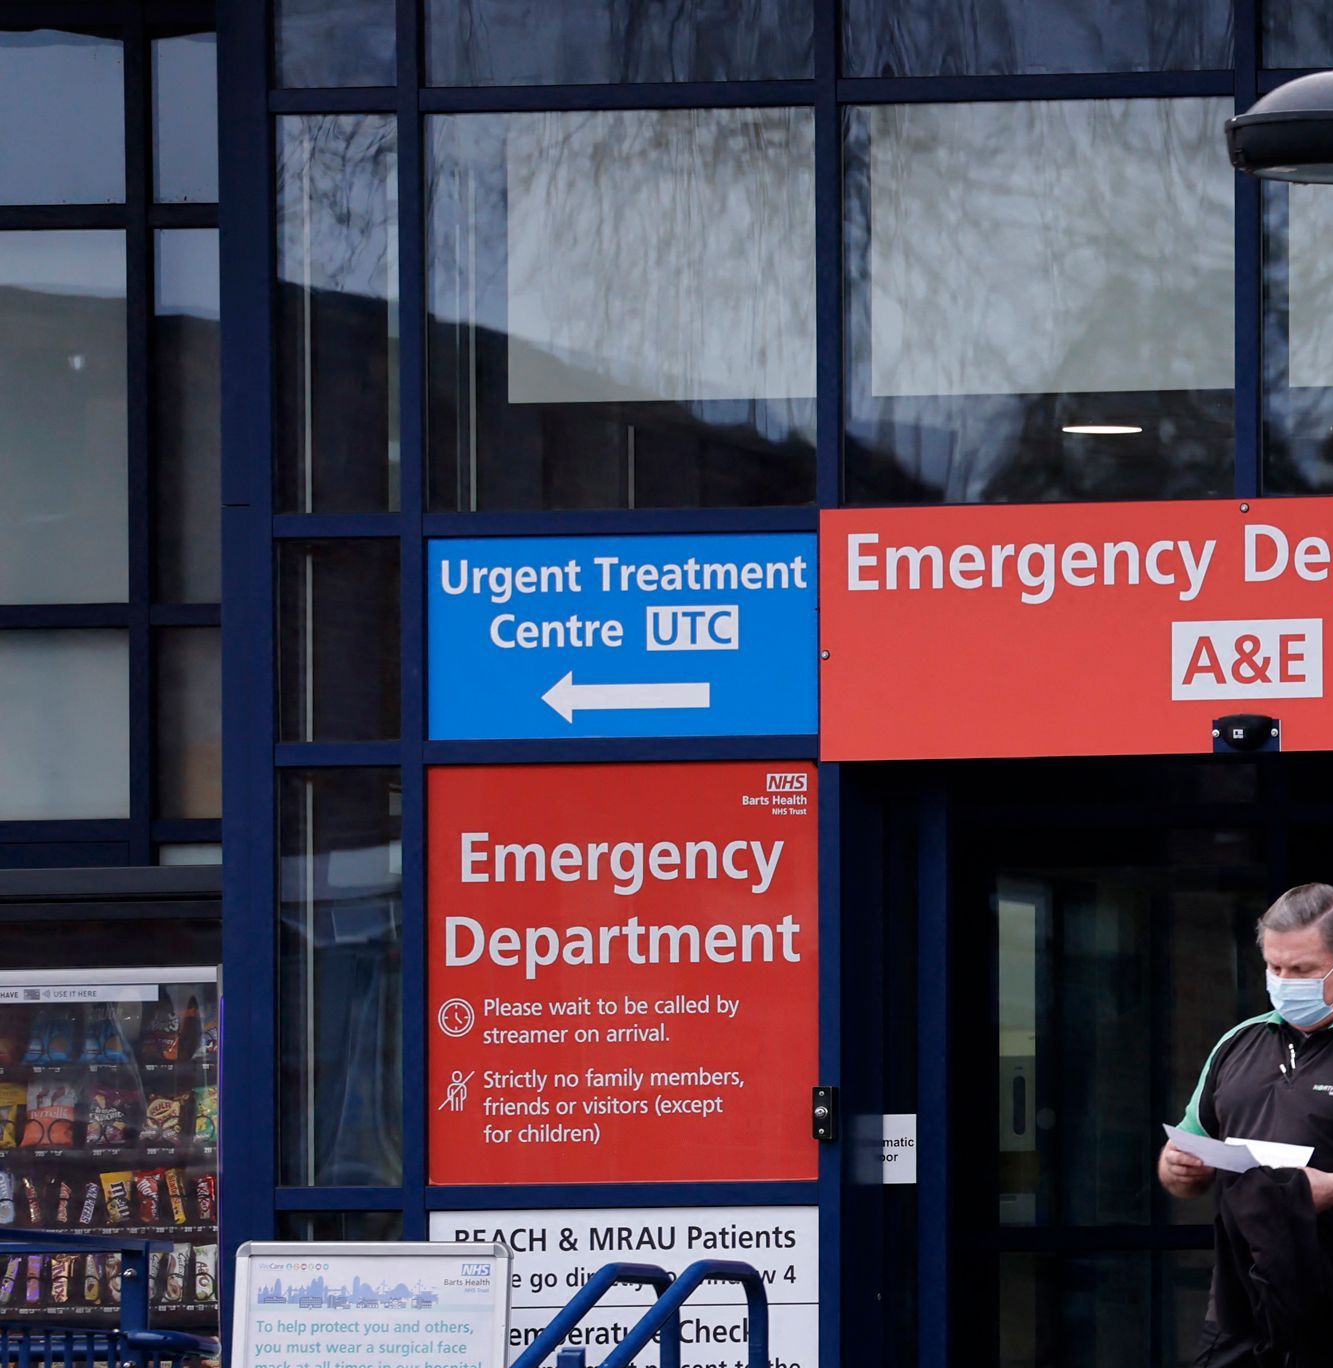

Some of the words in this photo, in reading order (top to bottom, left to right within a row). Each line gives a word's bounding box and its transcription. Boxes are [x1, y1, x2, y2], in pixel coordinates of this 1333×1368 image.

[440, 557, 582, 603] Urgent
[594, 555, 808, 593] Treatment
[846, 531, 1217, 605] Emergency
[489, 613, 624, 650] Centre
[651, 610, 734, 646] UTC
[1181, 633, 1308, 686] A&E
[767, 774, 806, 791] NHS
[742, 795, 769, 806] Barts
[772, 794, 807, 806] Health
[772, 808, 787, 816] NHS
[789, 807, 807, 816] Trust
[460, 832, 785, 896] Emergency
[444, 914, 801, 980] Department
[53, 990, 68, 998] USE
[77, 990, 97, 998] HERE
[484, 998, 543, 1018] Please
[549, 997, 591, 1017] wait
[597, 998, 618, 1016] to
[624, 996, 649, 1016] be
[655, 995, 711, 1015] called
[717, 995, 740, 1019] by
[483, 1026, 568, 1045] streamer
[574, 1027, 600, 1043] on
[605, 1023, 670, 1043] arrival.
[483, 1068, 548, 1093] Strictly
[553, 1072, 580, 1088] no
[585, 1067, 644, 1093] family
[650, 1067, 745, 1089] members,
[483, 1096, 550, 1117] friends
[555, 1098, 576, 1115] or
[582, 1095, 649, 1115] visitors
[654, 1095, 723, 1118] (except
[483, 1124, 512, 1143] for
[518, 1122, 601, 1145] children)
[882, 1136, 914, 1148] matic
[558, 1227, 579, 1252] &
[589, 1226, 676, 1251] MRAU
[687, 1224, 796, 1250] Patients
[462, 1264, 490, 1276] NHS
[530, 1272, 557, 1293] go
[783, 1264, 796, 1284] 4
[443, 1278, 463, 1286] Barts
[465, 1278, 490, 1286] Health
[256, 1320, 273, 1333] To
[277, 1319, 307, 1336] help
[311, 1321, 359, 1336] protect
[363, 1323, 389, 1336] you
[394, 1319, 420, 1333] and
[425, 1319, 474, 1335] others,
[255, 1343, 281, 1357] you
[286, 1341, 321, 1354] must
[326, 1343, 361, 1354] wear
[366, 1343, 375, 1354] a
[378, 1340, 433, 1357] surgical
[437, 1339, 467, 1354] face
